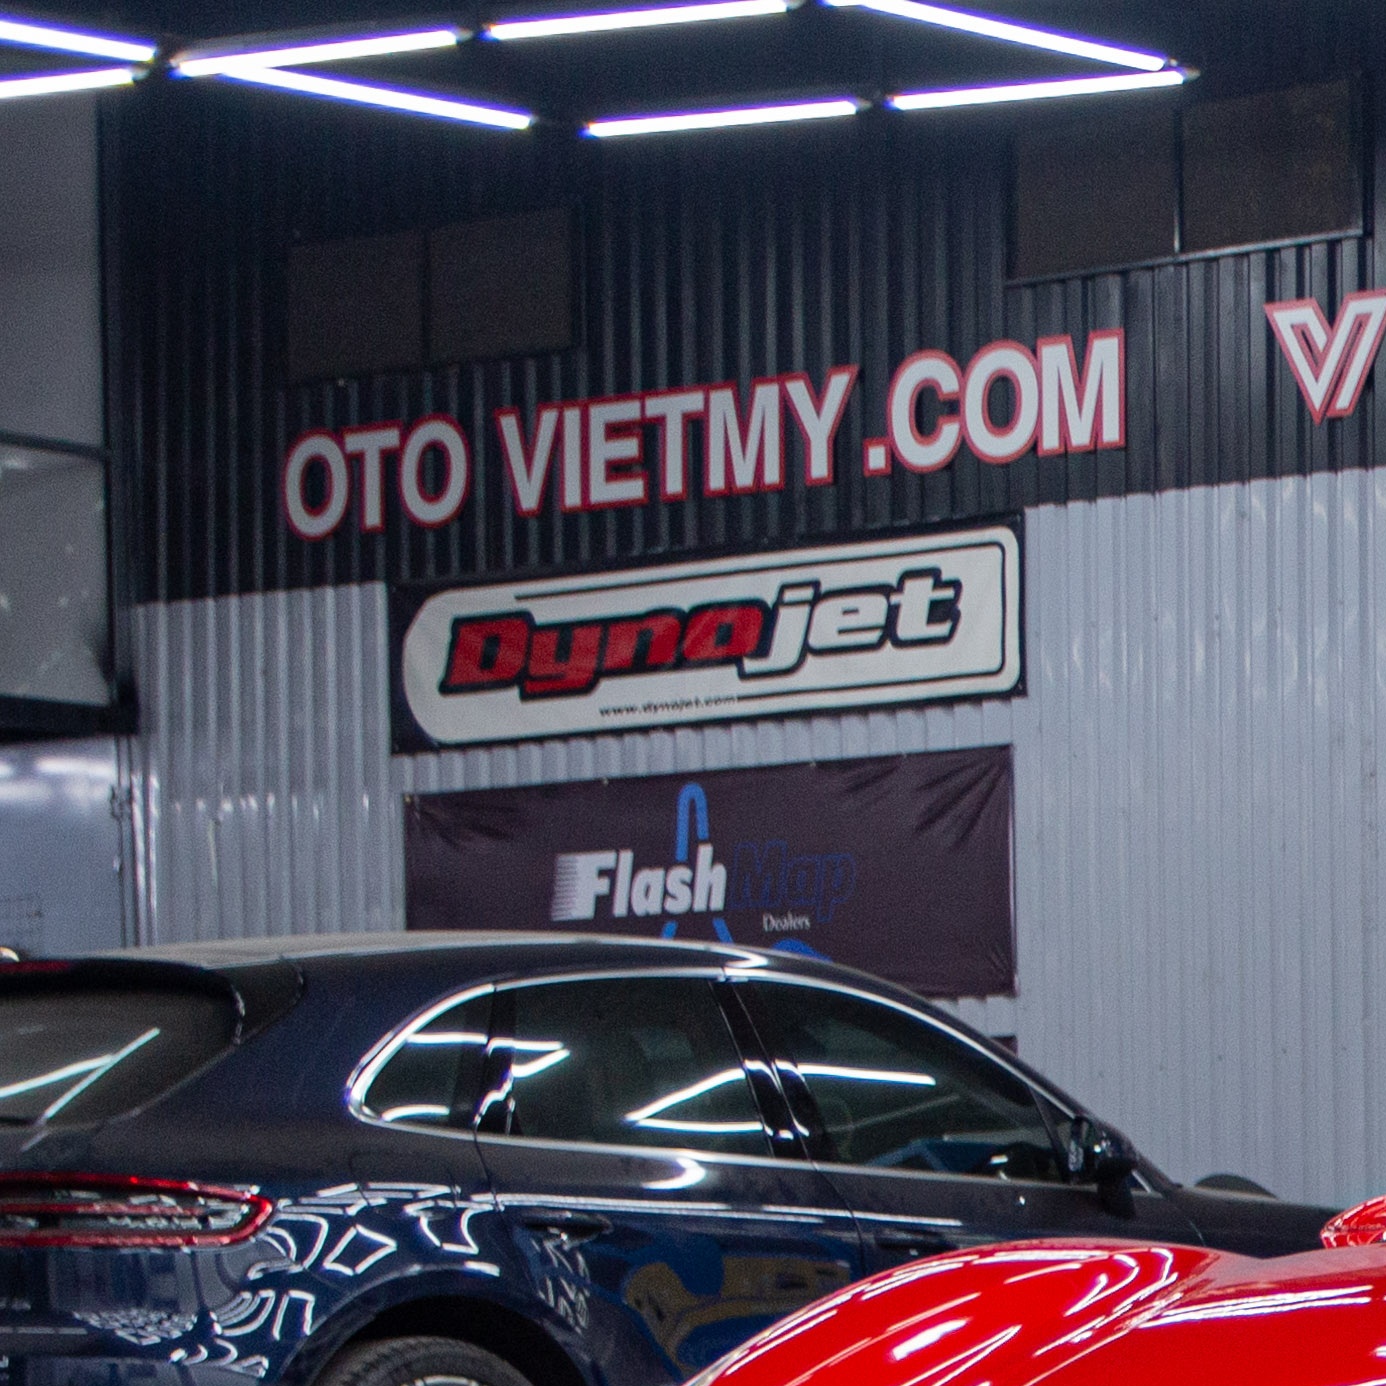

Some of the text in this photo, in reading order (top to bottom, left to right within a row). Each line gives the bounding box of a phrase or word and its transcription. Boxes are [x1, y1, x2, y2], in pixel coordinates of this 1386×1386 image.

[283, 413, 470, 541] OTO
[440, 569, 962, 699] Dynojet
[550, 843, 728, 922] Flash
[761, 910, 812, 933] Dealers
